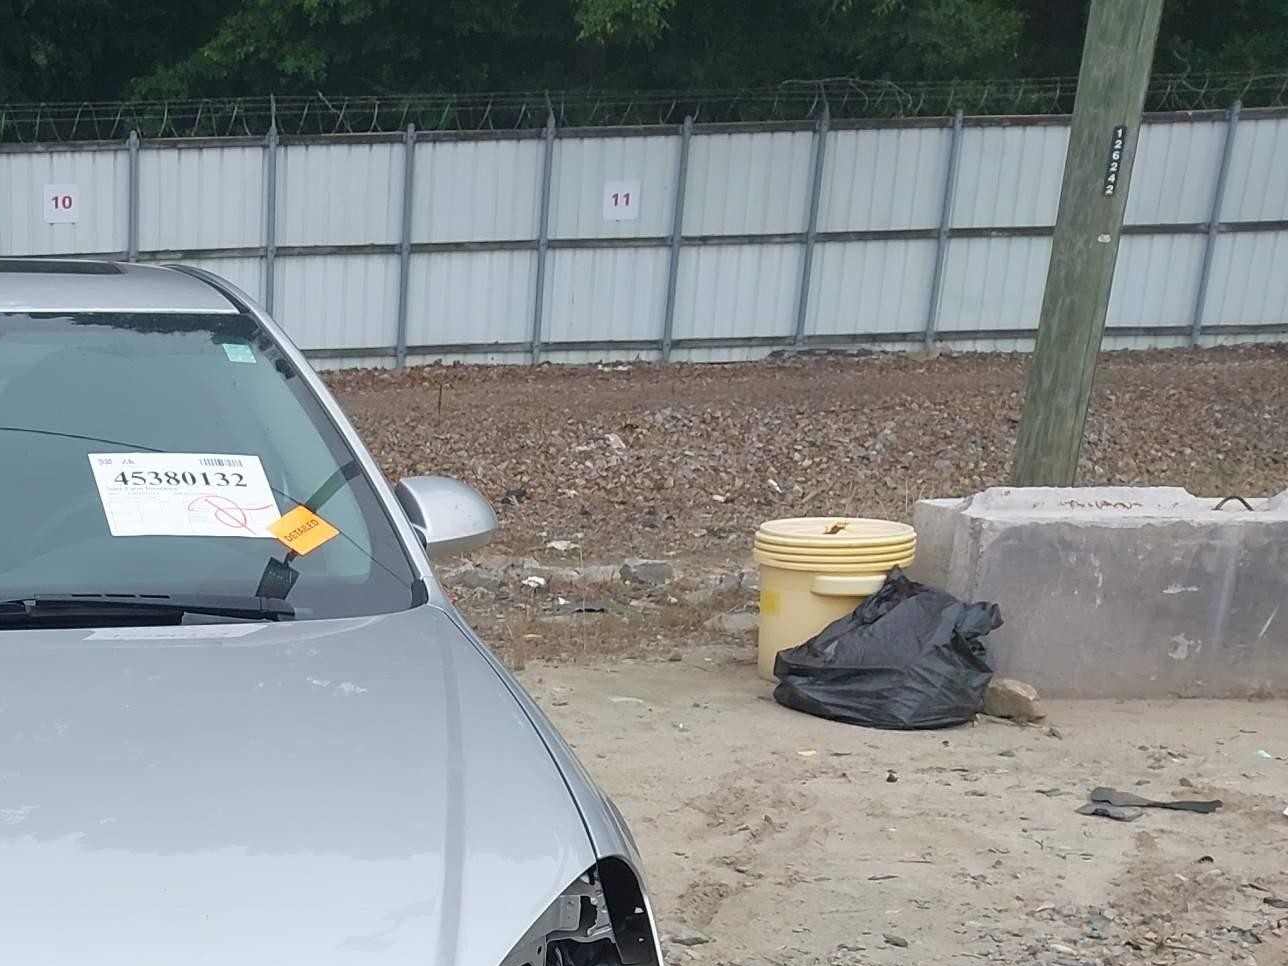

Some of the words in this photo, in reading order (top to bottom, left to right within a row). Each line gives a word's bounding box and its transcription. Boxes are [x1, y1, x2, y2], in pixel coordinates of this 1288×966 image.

[1105, 128, 1124, 195] 126242
[51, 195, 73, 210] 10
[611, 192, 632, 207] 11
[114, 471, 248, 488] 45380132
[284, 518, 320, 543] DETAILED
